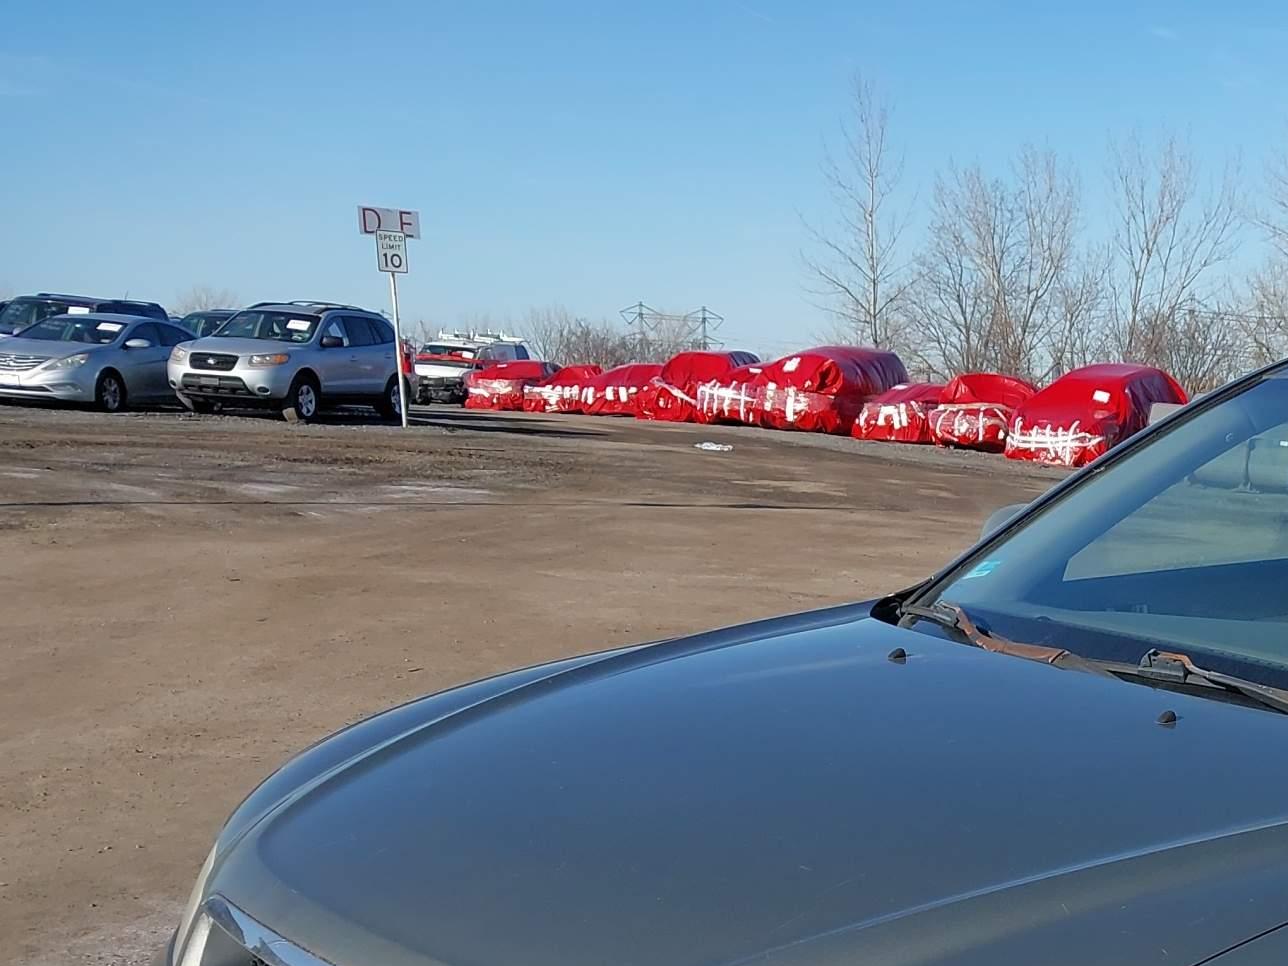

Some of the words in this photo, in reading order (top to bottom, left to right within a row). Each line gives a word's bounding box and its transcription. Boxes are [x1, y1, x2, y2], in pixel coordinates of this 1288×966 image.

[362, 207, 381, 234] D
[379, 233, 403, 242] SPEED
[382, 252, 402, 268] 10
